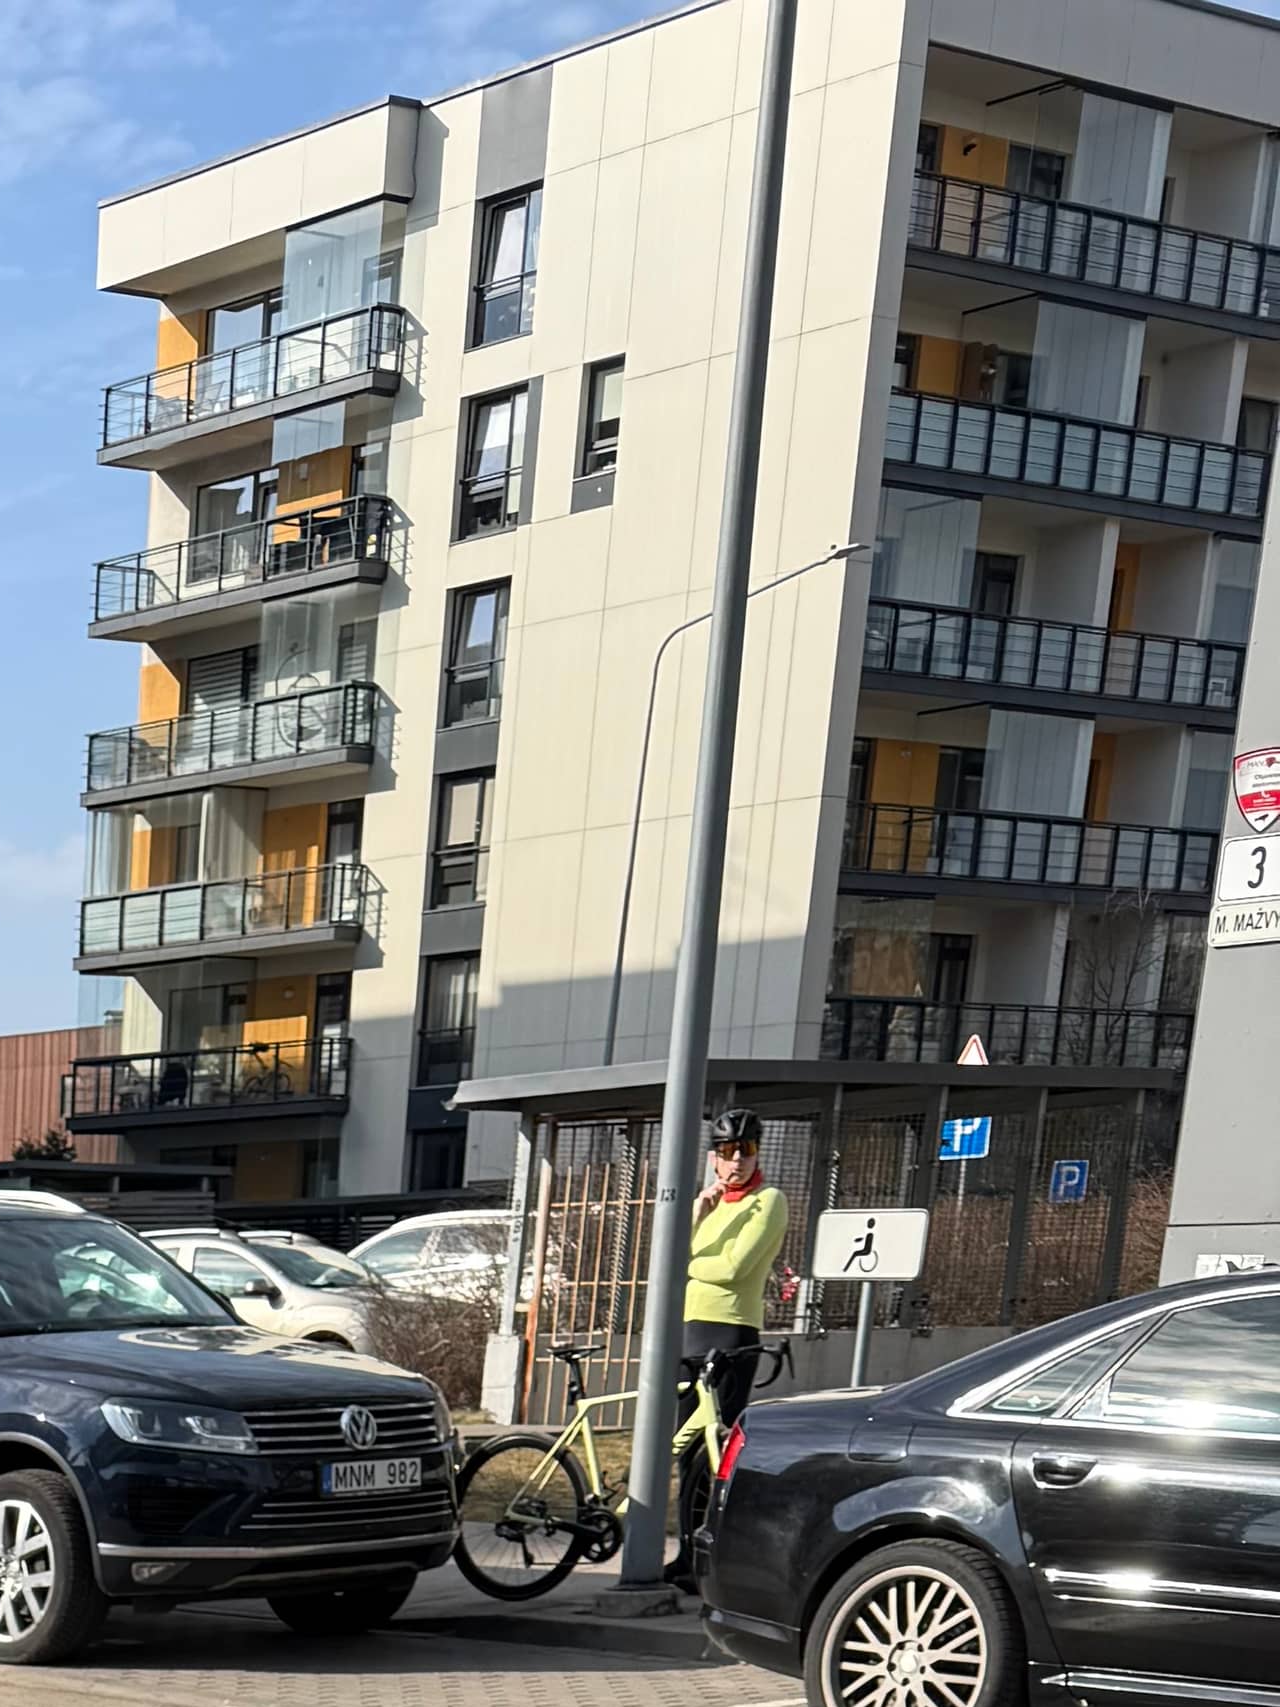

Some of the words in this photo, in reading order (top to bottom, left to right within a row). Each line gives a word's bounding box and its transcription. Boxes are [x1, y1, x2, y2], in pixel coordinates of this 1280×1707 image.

[1247, 846, 1267, 889] 3
[1214, 914, 1229, 935] M.
[1058, 1166, 1080, 1198] P
[334, 1463, 376, 1489] MNM
[386, 1460, 419, 1485] 982
